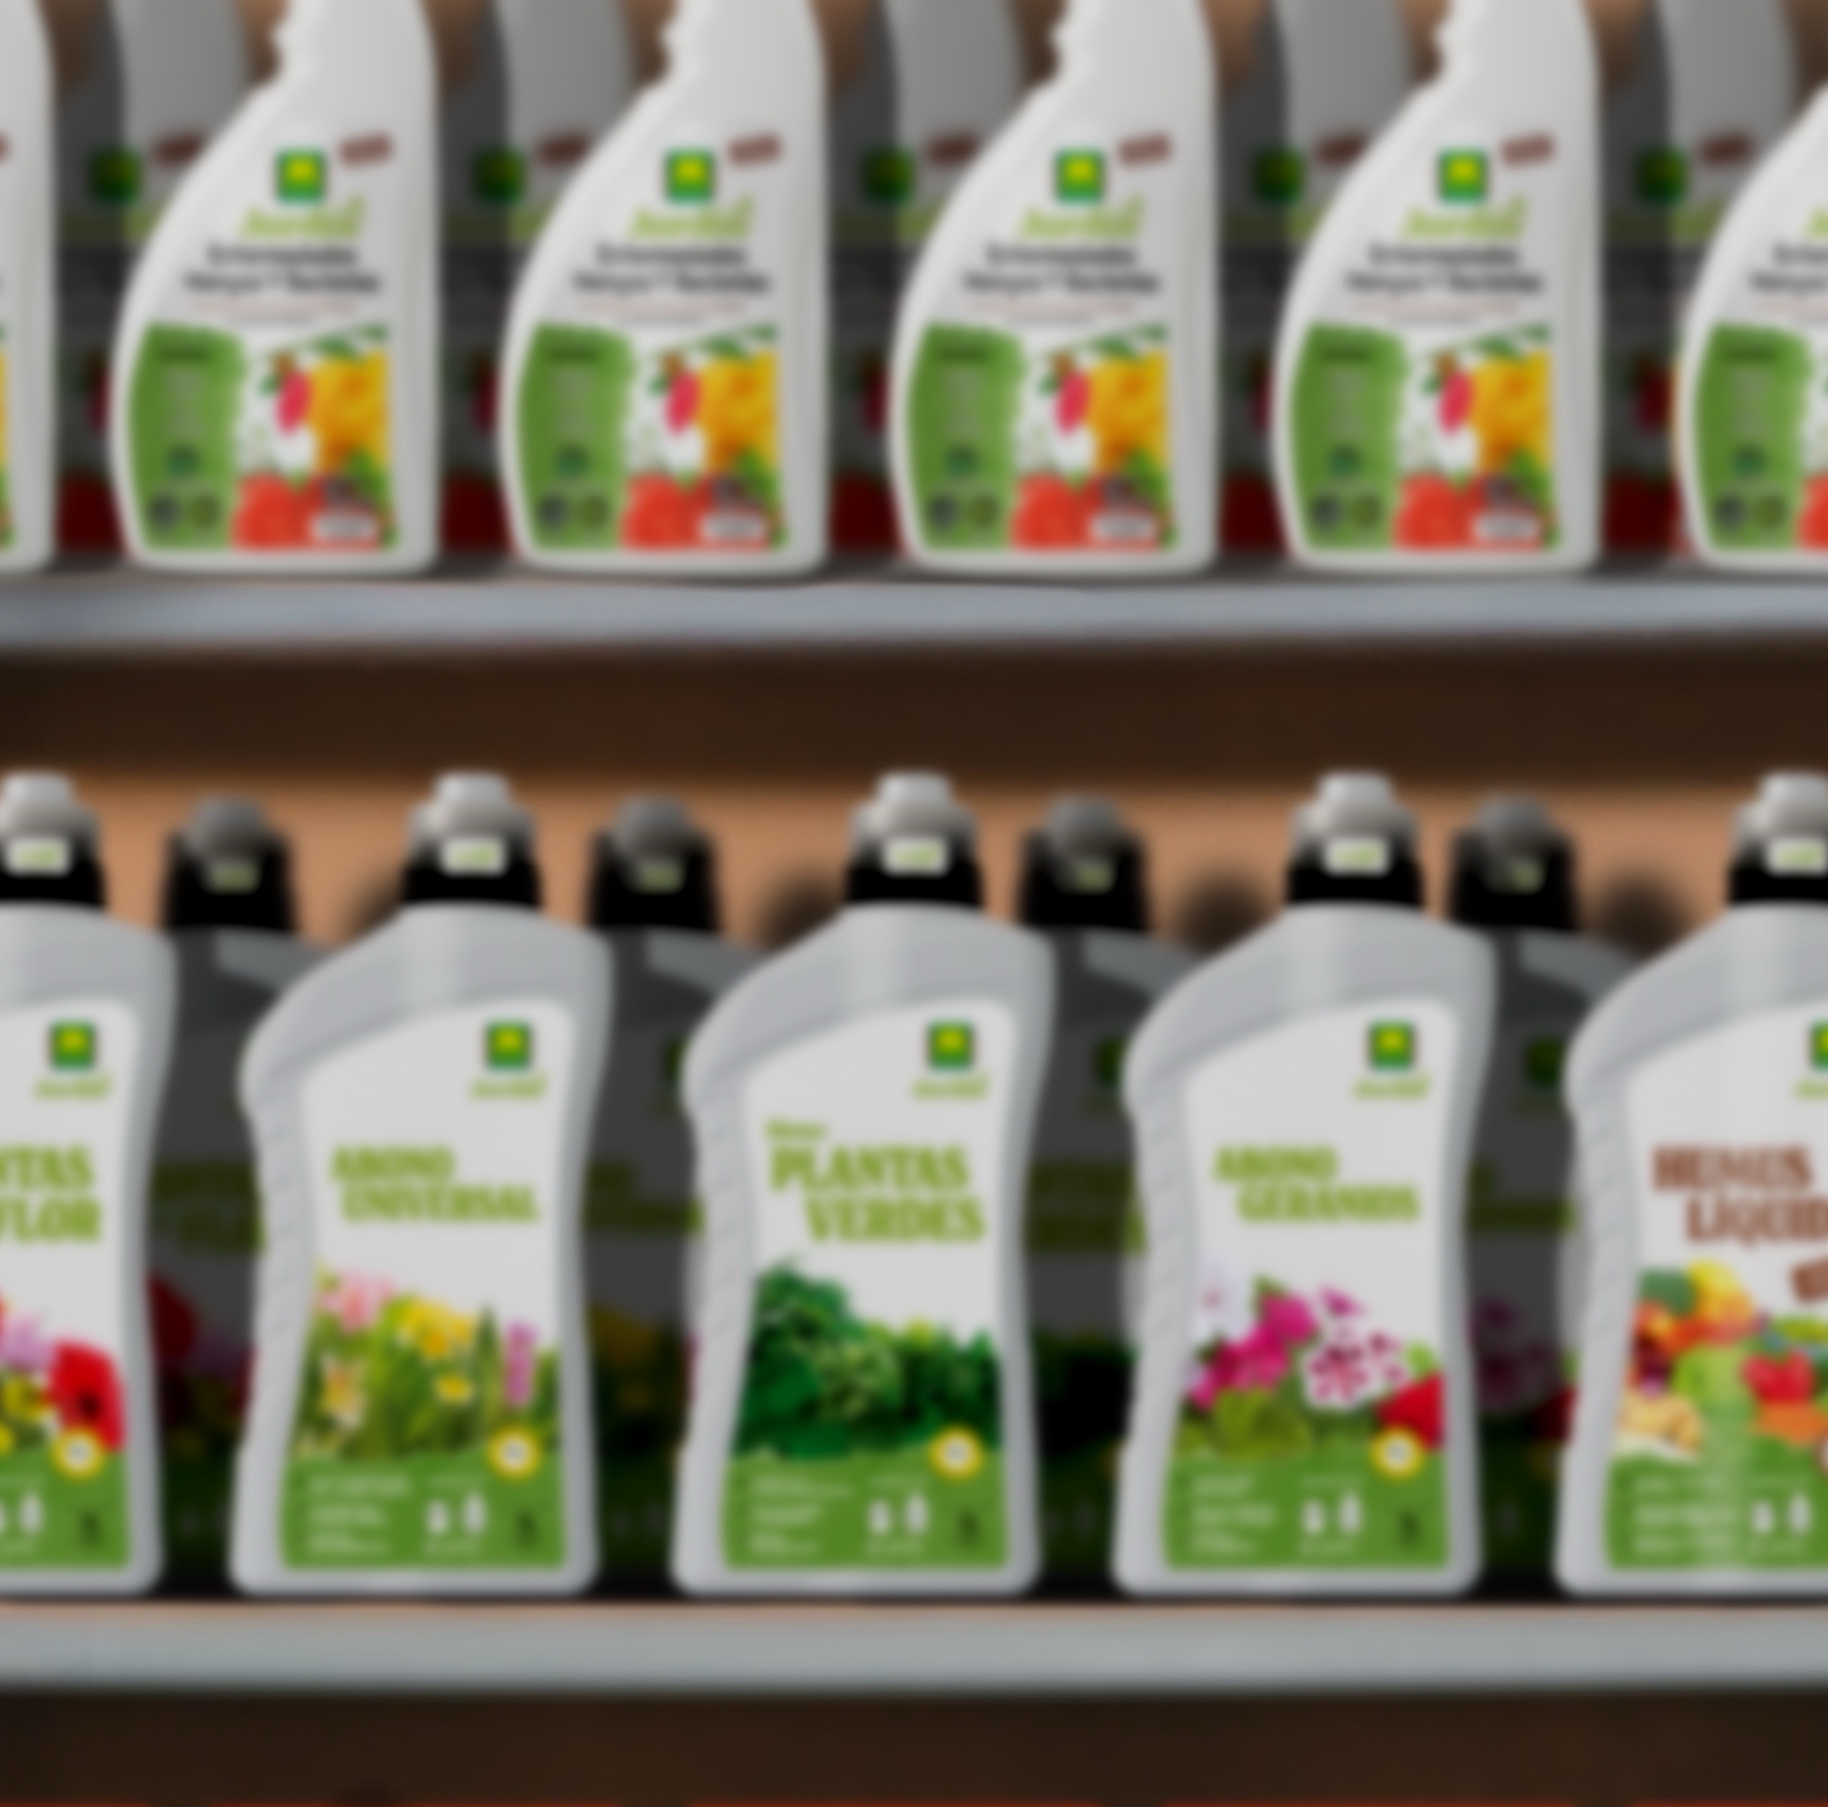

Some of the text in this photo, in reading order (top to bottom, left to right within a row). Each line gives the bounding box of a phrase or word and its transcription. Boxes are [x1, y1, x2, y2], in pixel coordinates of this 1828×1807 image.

[769, 1147, 968, 1191] PLANTAS
[1653, 1147, 1812, 1191] HUMUS
[341, 1186, 538, 1223] UNIVERSAL
[805, 1197, 984, 1242] VERDES
